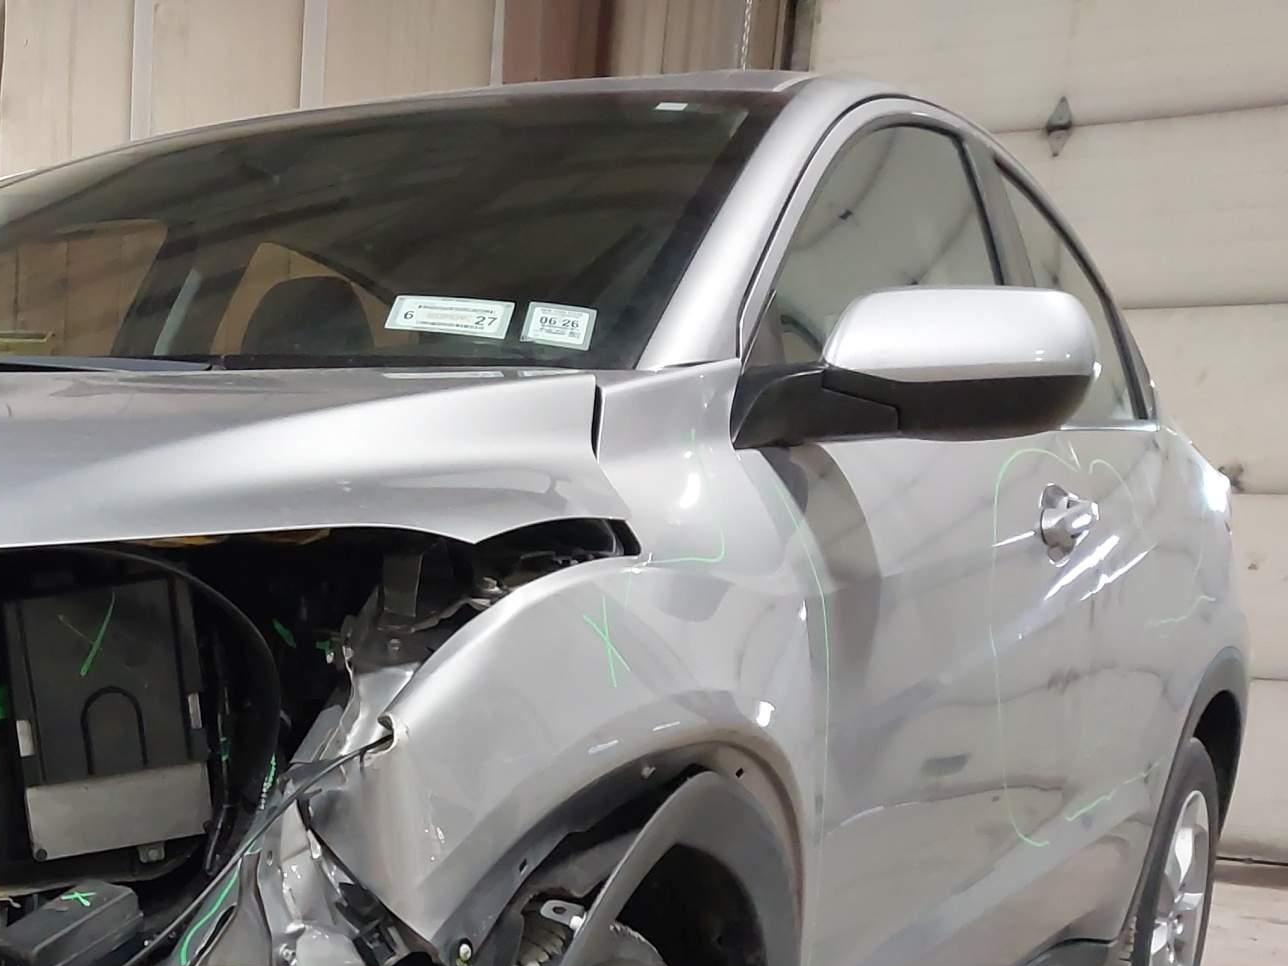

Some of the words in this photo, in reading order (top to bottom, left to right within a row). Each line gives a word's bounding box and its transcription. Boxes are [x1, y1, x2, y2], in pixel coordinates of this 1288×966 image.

[403, 310, 415, 320] 6
[474, 315, 498, 327] 27
[539, 316, 557, 325] 06
[562, 318, 580, 328] 26
